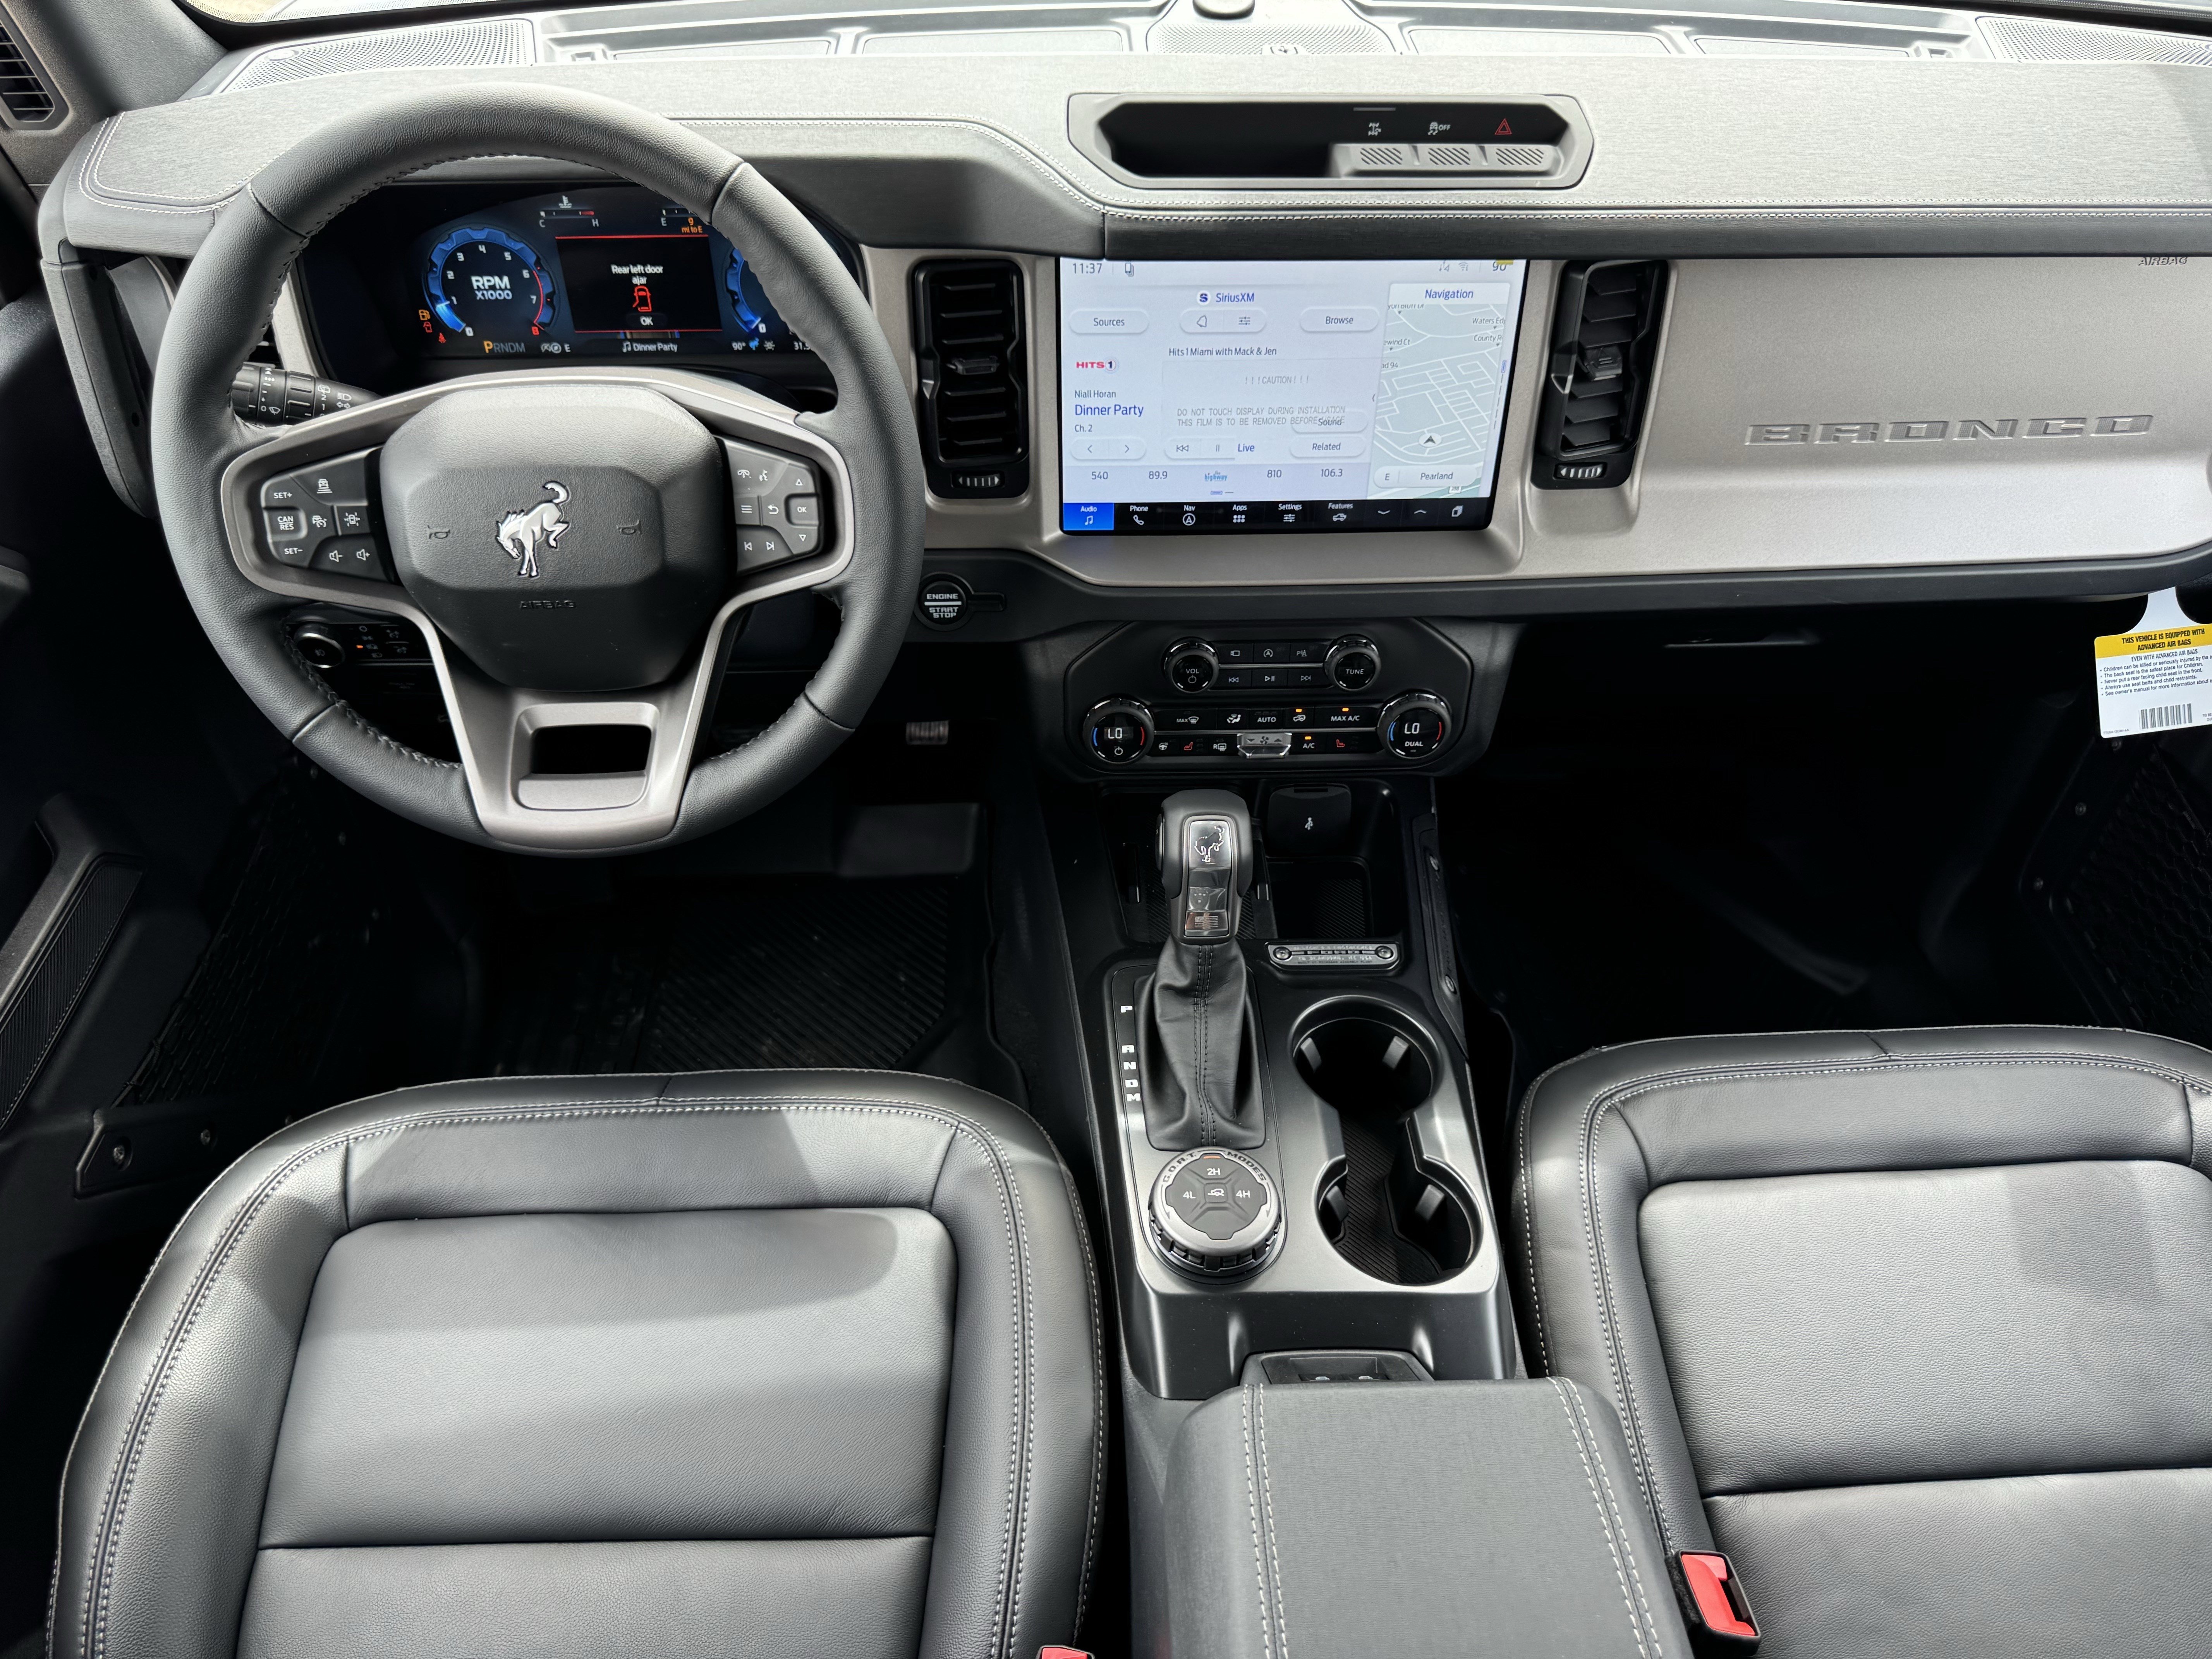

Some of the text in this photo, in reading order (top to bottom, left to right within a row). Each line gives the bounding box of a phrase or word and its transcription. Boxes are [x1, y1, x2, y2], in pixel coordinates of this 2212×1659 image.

[592, 219, 599, 227] H
[661, 218, 667, 226] E
[688, 217, 694, 226] 9
[479, 245, 486, 253] 4
[457, 252, 464, 261] 3
[504, 252, 512, 260] 5
[2138, 257, 2188, 266] AIRBAG
[611, 263, 663, 274] Rear left door
[1073, 263, 1102, 274] 11:37
[447, 271, 455, 279] 2
[522, 270, 530, 278] 6
[471, 275, 510, 289] RPM
[632, 275, 647, 285] ajar
[474, 290, 512, 300] X1000
[1216, 293, 1254, 302] SiriusXM
[1425, 289, 1474, 300] Navigation
[451, 296, 457, 305] 1
[530, 295, 537, 304] 7
[640, 316, 653, 326] OK
[1094, 318, 1125, 326] Sources
[1325, 316, 1353, 324] Browse
[465, 327, 474, 336] 0
[531, 326, 539, 335] 8
[759, 323, 766, 333] 0
[633, 342, 678, 353] Dinner Party
[1169, 347, 1277, 356] Hits 1 Miami with Mack & Jen
[1107, 361, 1113, 369] 1
[1262, 376, 1292, 385] CAUTION
[1075, 390, 1116, 398] Niall Horan
[1075, 404, 1144, 417] Dinner Party
[1236, 407, 1264, 415] DISPLAY
[1268, 407, 1294, 415] DURING
[1298, 406, 1345, 414] INSTALLATION
[1239, 417, 1249, 426] BE
[1253, 417, 1286, 425] REMOVED
[1290, 416, 1317, 425] BEFORE
[1318, 418, 1342, 426] Sound
[1075, 424, 1087, 433] Ch.
[1745, 415, 2154, 446] BRONCO
[1238, 444, 1255, 452] Live
[1312, 443, 1341, 451] Related
[1091, 471, 1108, 480] 540
[1149, 471, 1168, 480] 89.9
[1204, 473, 1228, 481] highway
[1267, 470, 1282, 478] 810
[1321, 468, 1343, 477] 106.3
[1420, 472, 1453, 480] Pearland
[520, 601, 576, 609] AIRBAG
[2135, 634, 2157, 642] VEHICLE
[2165, 630, 2190, 639] EQUIPPED
[2138, 642, 2165, 651] ADVANCED
[1404, 723, 1420, 734] LO
[1108, 728, 1123, 739] LO
[1123, 1061, 1136, 1070] N
[1125, 1079, 1138, 1087] D
[1127, 1093, 1141, 1101] M
[1227, 1151, 1266, 1181] MODES
